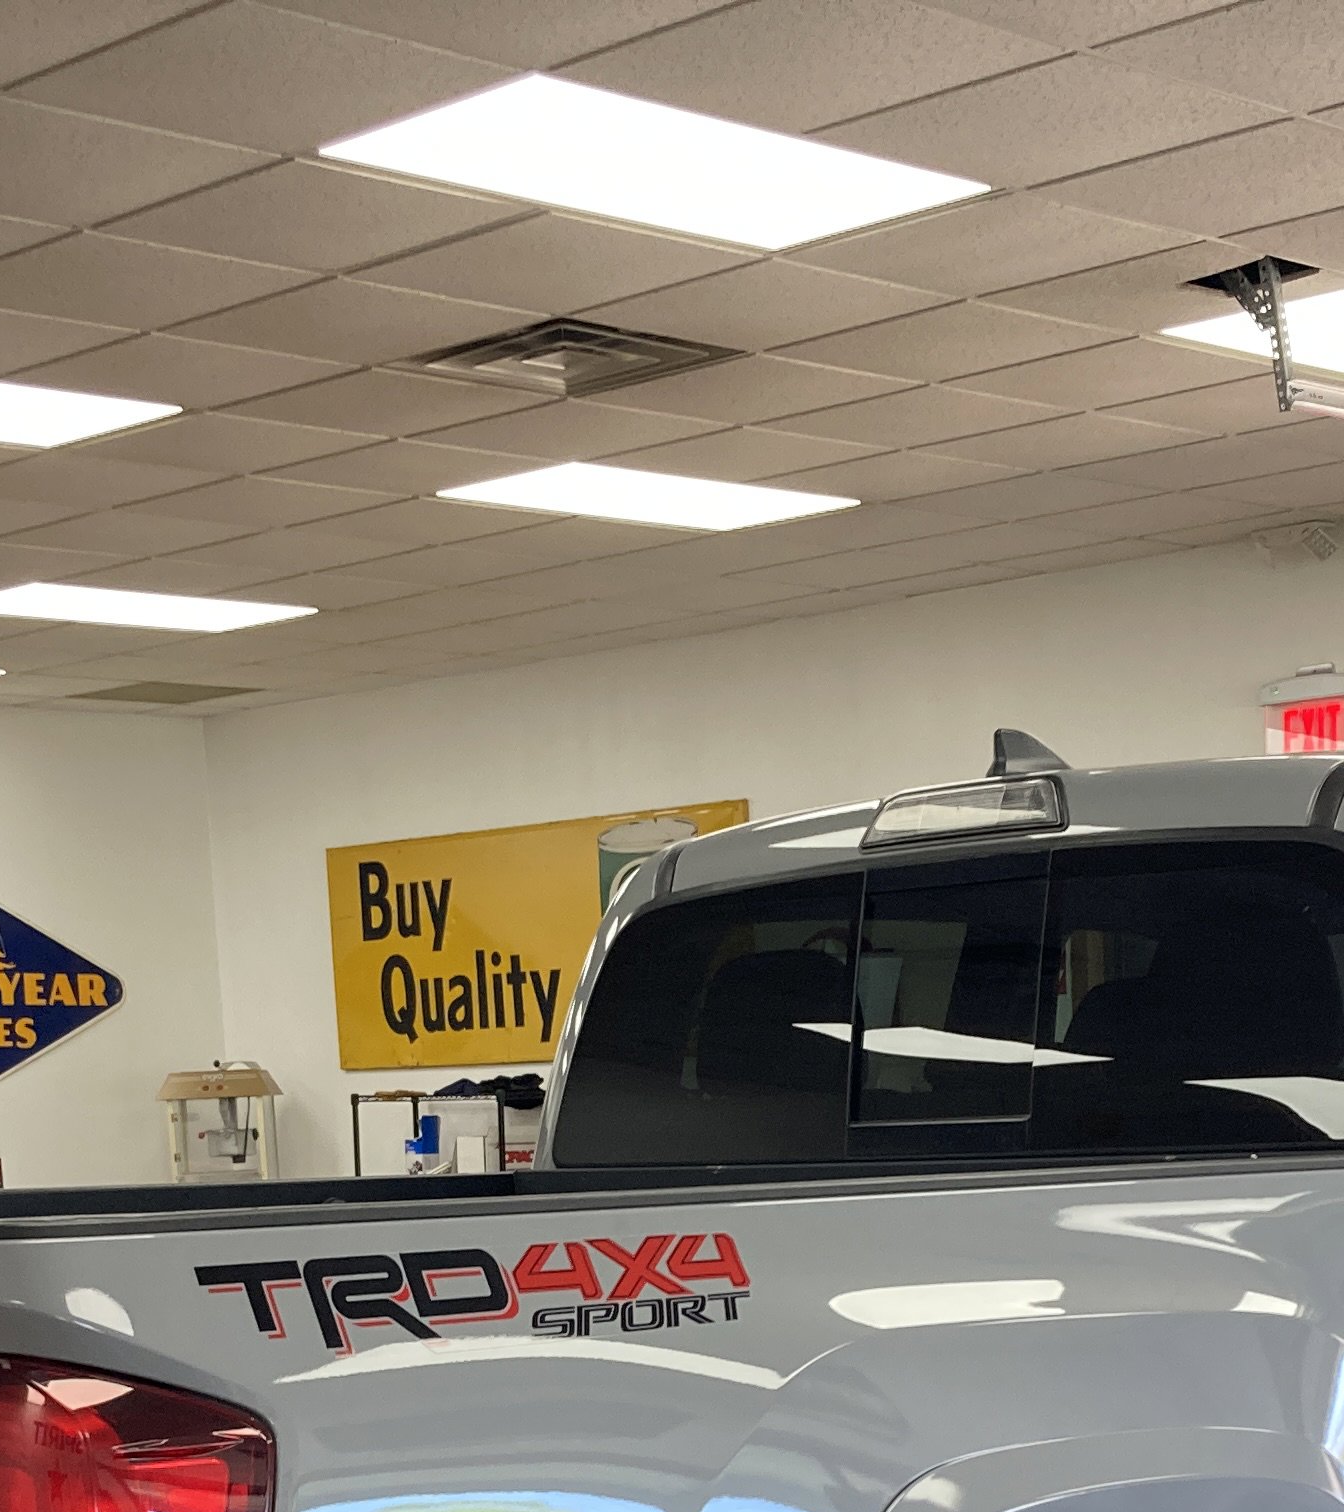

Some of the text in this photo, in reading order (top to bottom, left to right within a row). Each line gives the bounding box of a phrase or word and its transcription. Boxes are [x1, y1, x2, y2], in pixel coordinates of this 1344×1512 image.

[1283, 703, 1341, 753] EXIT
[358, 860, 453, 952] Buy
[380, 949, 562, 1045] Quality
[194, 1232, 751, 1356] TRD 4X4
[530, 1290, 751, 1339] SPORT
